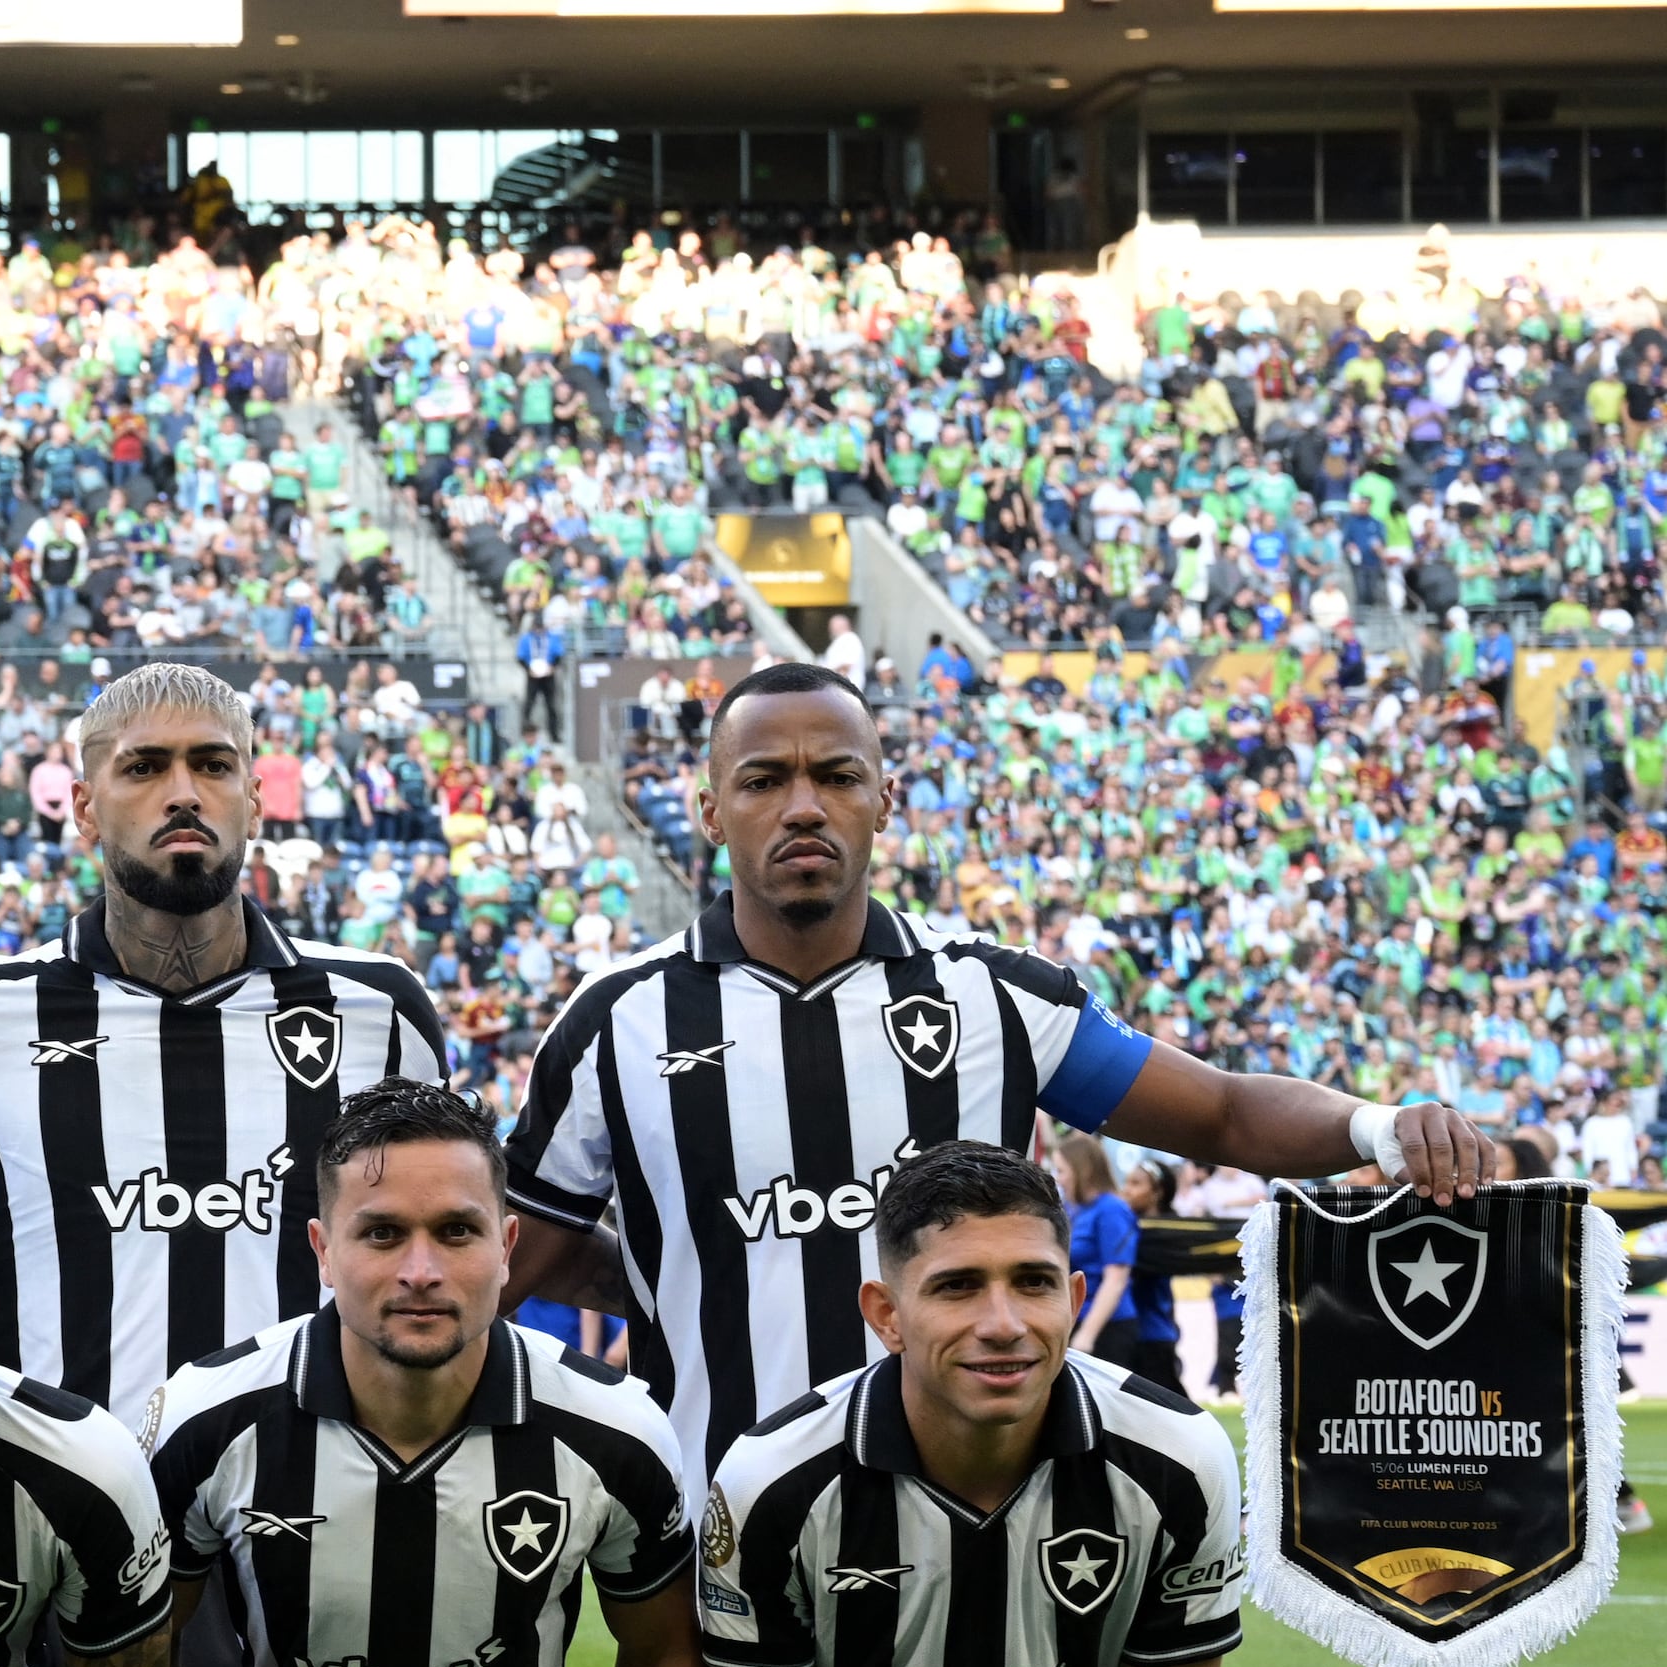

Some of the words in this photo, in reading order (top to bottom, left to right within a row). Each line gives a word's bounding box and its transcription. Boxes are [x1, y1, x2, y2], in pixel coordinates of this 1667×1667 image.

[91, 1172, 269, 1230] vbet
[724, 1169, 889, 1238] vbe
[1355, 1378, 1476, 1417] BOTAFOGO
[1480, 1390, 1503, 1417] VS
[1318, 1418, 1412, 1455] SEATTLE
[1416, 1419, 1543, 1458] SOUNDERS
[1370, 1462, 1405, 1475] 15/06
[1407, 1462, 1452, 1475] LUMEN
[1453, 1463, 1489, 1475] FIELD
[1376, 1478, 1432, 1491] SEATTLE,
[1433, 1479, 1455, 1491] WA
[1457, 1480, 1484, 1492] USA
[1360, 1519, 1381, 1529] FIFA
[1383, 1520, 1408, 1529] CLUB
[1410, 1520, 1448, 1530] WORLD
[1449, 1521, 1470, 1530] CUP
[1378, 1558, 1422, 1580] CLUB
